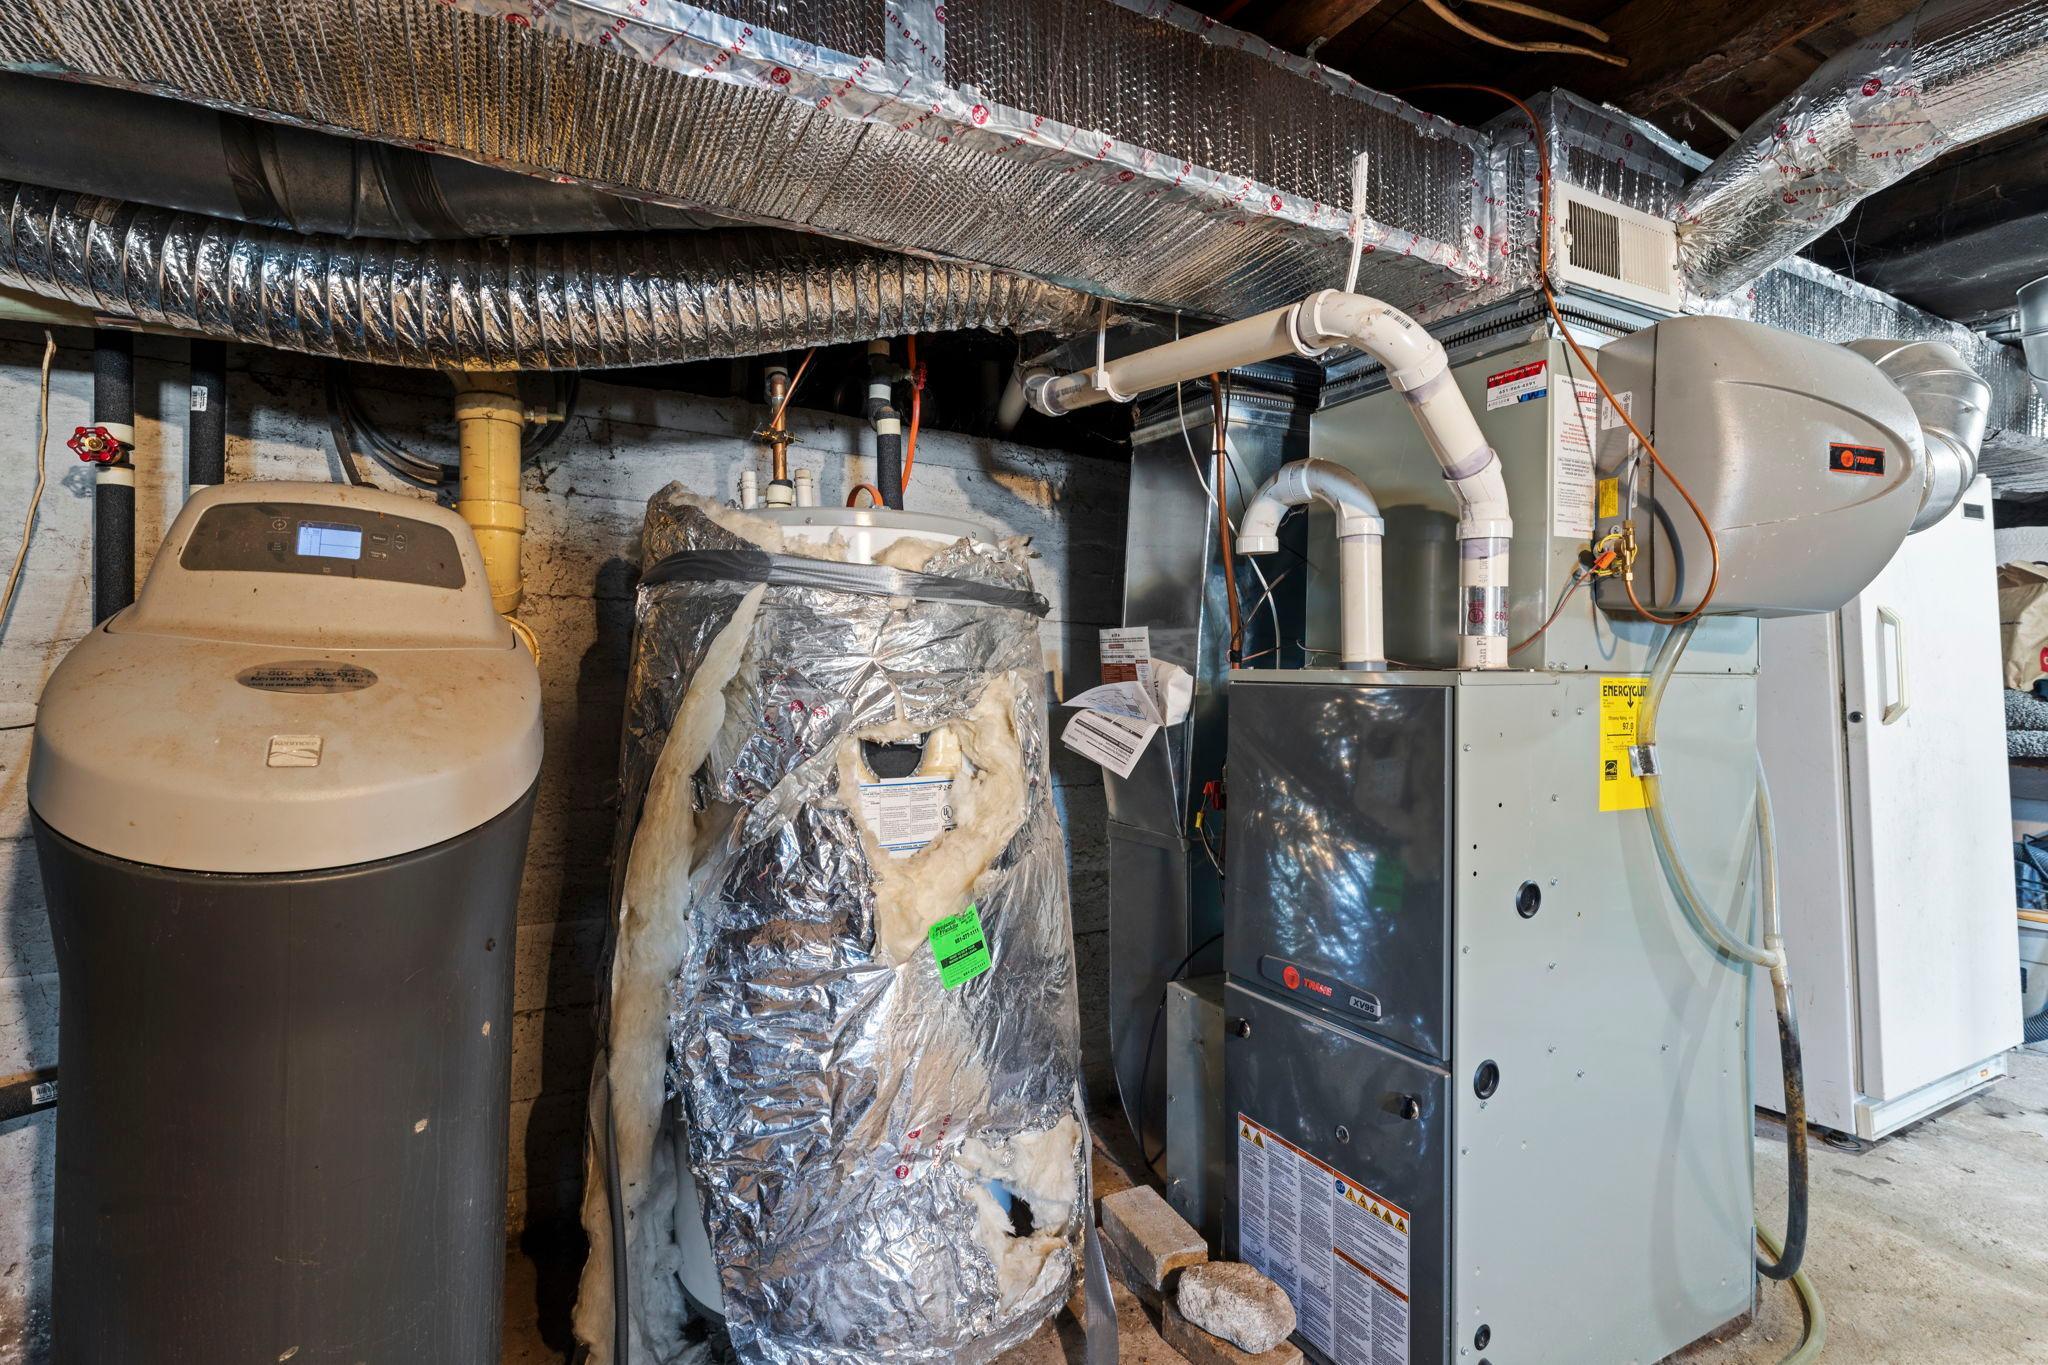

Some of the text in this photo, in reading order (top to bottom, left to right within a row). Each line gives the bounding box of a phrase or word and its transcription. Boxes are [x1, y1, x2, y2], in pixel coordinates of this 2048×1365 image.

[1856, 456, 1876, 465] TRANE
[1303, 978, 1333, 997] TRANE
[1353, 998, 1375, 1013] XV95
